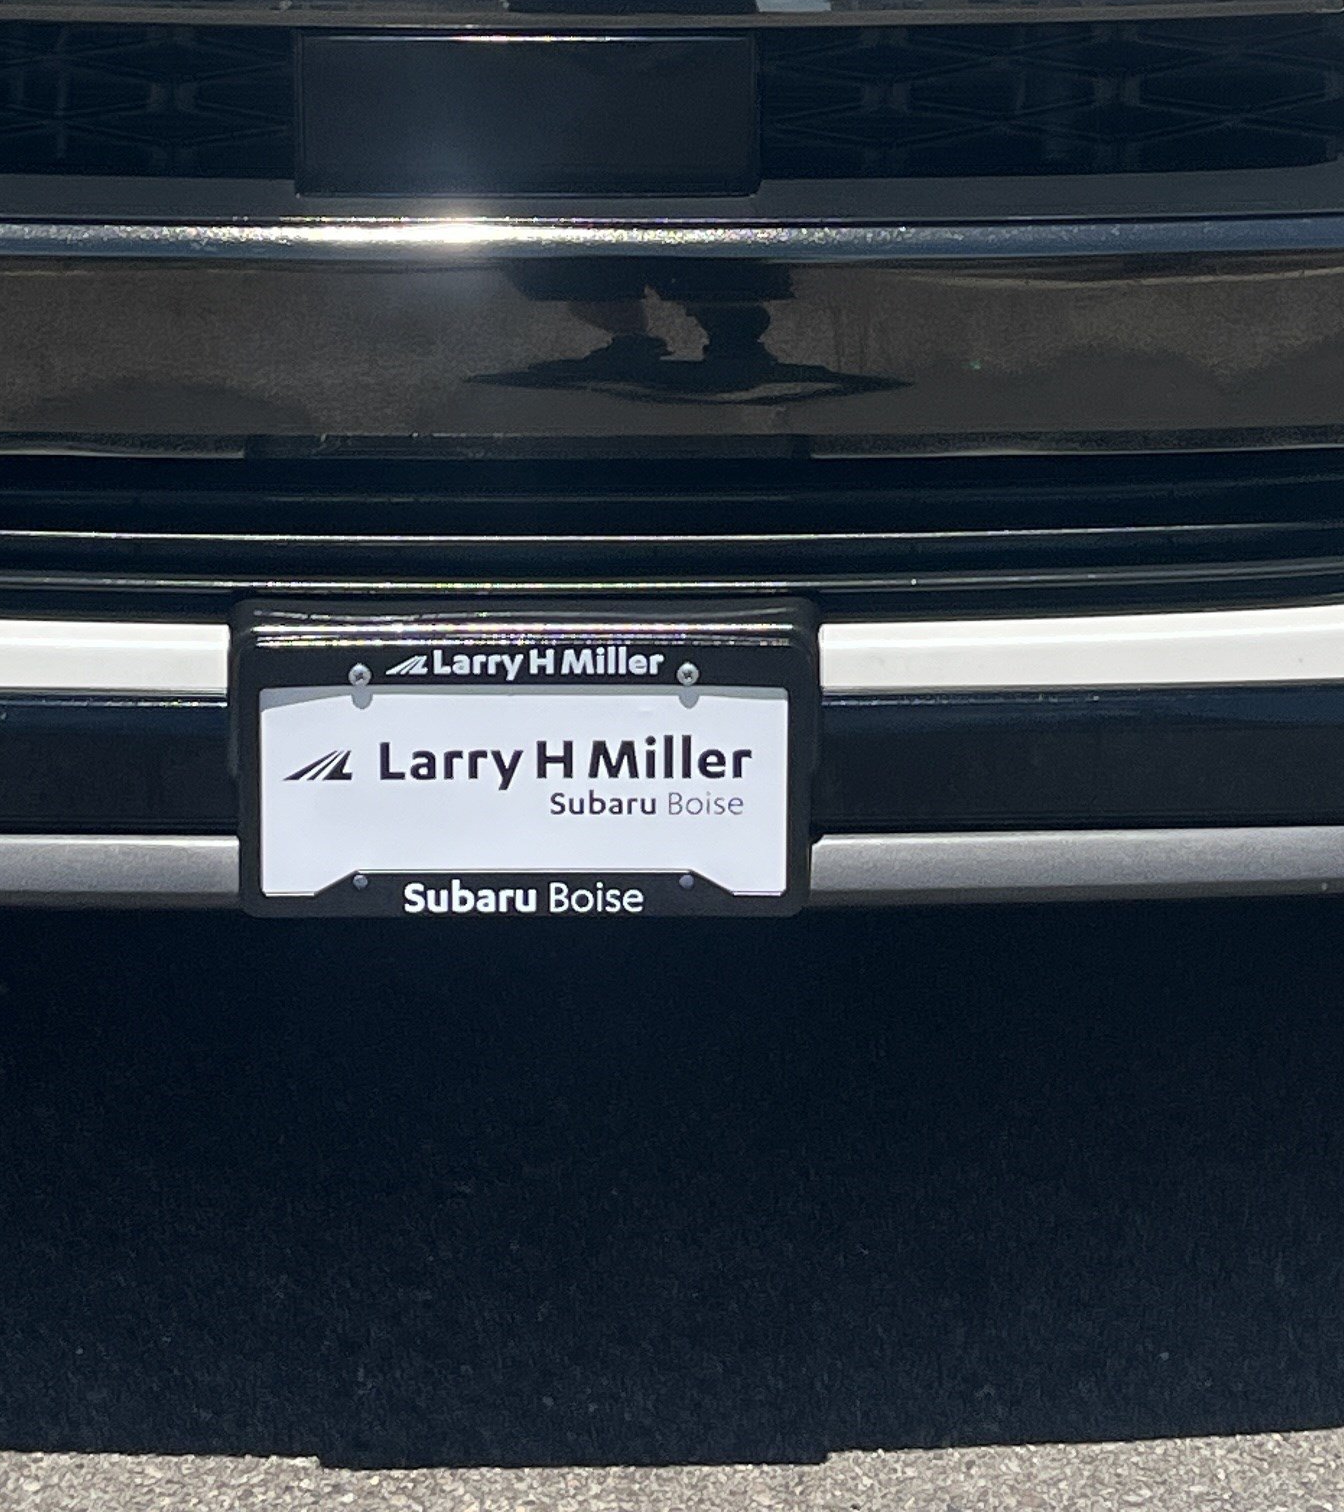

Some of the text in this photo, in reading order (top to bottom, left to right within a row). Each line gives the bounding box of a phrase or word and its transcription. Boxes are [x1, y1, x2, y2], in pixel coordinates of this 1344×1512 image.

[433, 647, 665, 681] Larry H Miller
[379, 734, 753, 791] Larry H Miller
[550, 790, 745, 816] Subaru Boise
[404, 881, 644, 913] Subaru Boise
